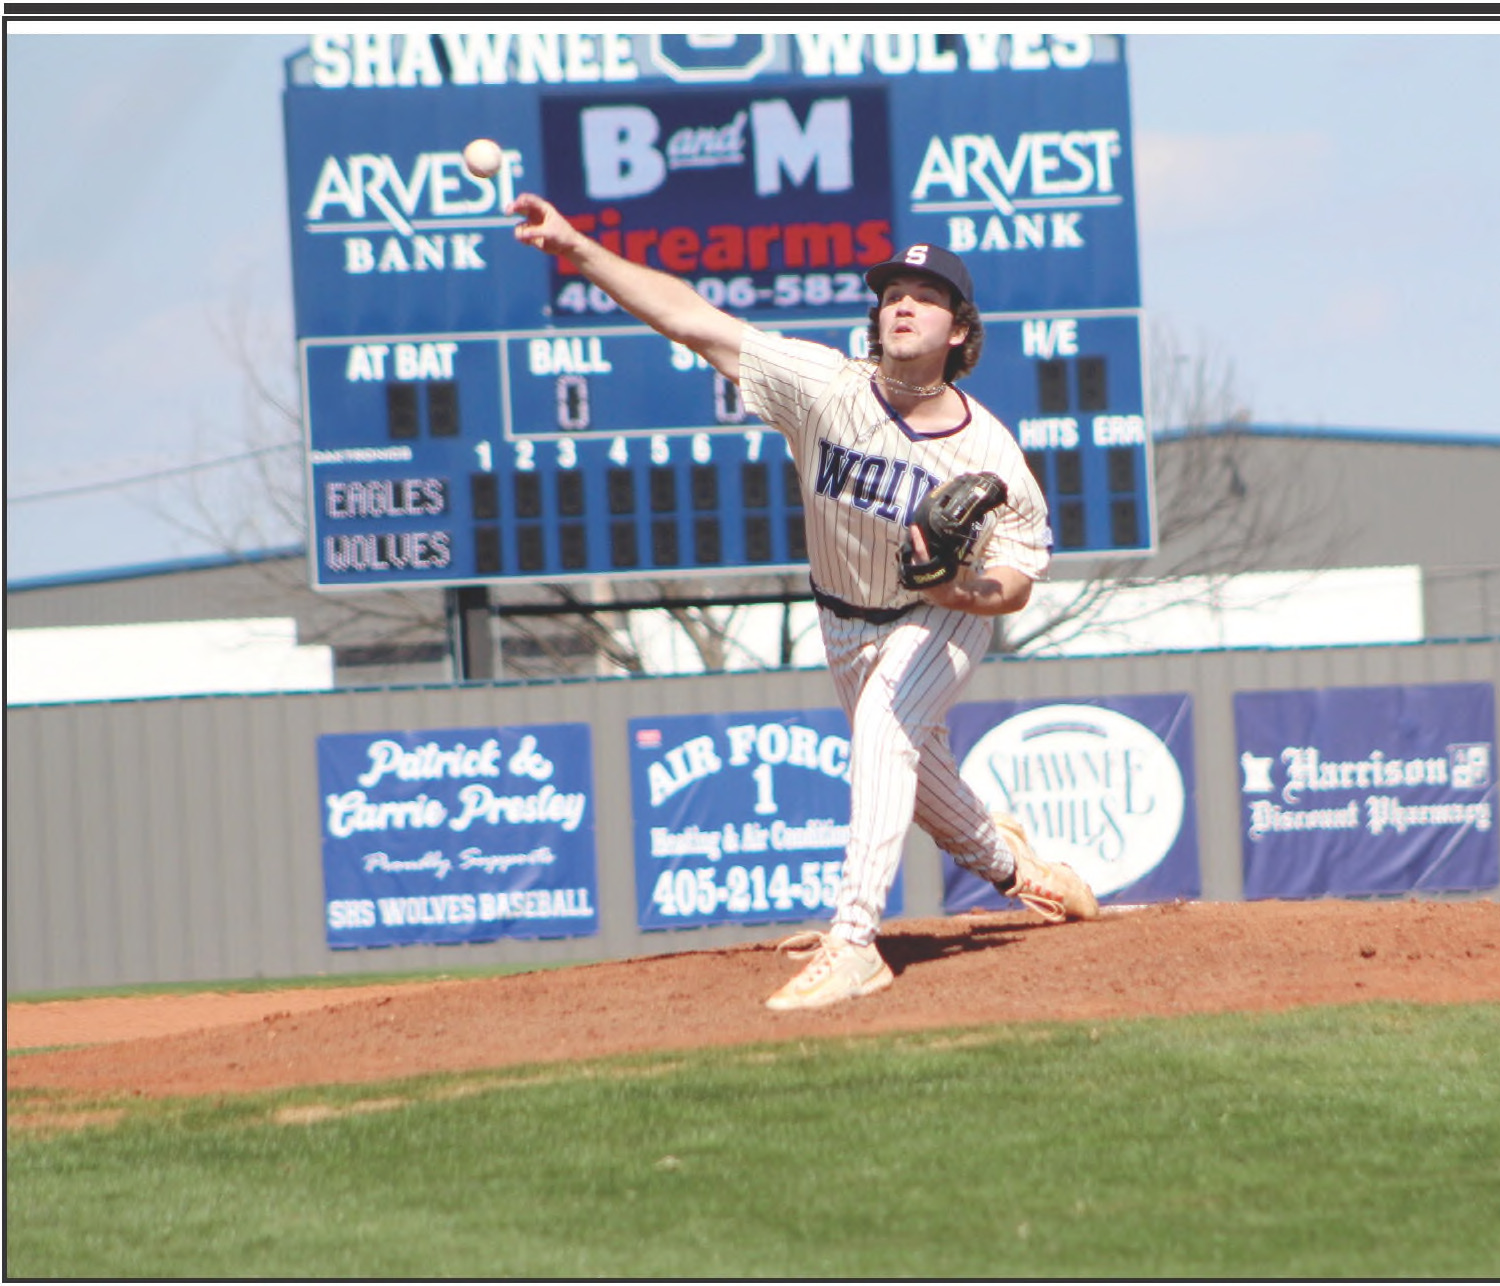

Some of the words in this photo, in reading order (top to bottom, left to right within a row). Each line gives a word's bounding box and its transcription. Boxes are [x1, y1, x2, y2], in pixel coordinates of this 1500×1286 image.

[310, 34, 639, 88] SHAWNEE
[795, 34, 1094, 77] WOLVES
[580, 106, 667, 199] B
[667, 111, 748, 158] and
[751, 98, 853, 196] M
[307, 150, 523, 236] ARVEST
[911, 129, 1121, 215] ARVEST
[344, 233, 487, 274] BANK
[947, 212, 1086, 252] BANK
[905, 245, 929, 265] S
[529, 337, 611, 375] BALL
[1022, 319, 1078, 360] H/E
[346, 345, 389, 381] AT
[395, 342, 458, 380] BAT
[475, 441, 492, 472] 1
[515, 438, 535, 471] 2
[557, 437, 577, 469] 3
[608, 436, 629, 467] 4
[651, 433, 671, 465] 5
[692, 432, 712, 464] 6
[743, 431, 763, 462] 7
[1019, 417, 1079, 451] HITS
[1092, 415, 1146, 447] ERR
[326, 479, 445, 518] EAGLES
[814, 437, 943, 530] WOLV
[324, 531, 451, 571] WOLVES
[358, 738, 502, 788] Patrick
[647, 735, 722, 807] AIR
[726, 723, 852, 784] FORC
[1280, 745, 1448, 804] Harrison
[327, 789, 448, 838] Carrie
[448, 782, 586, 832] Presley
[752, 762, 778, 815] 1
[1248, 799, 1360, 840] Discount
[1365, 795, 1492, 835] Pharmacy
[650, 825, 722, 861] Heating
[741, 821, 769, 852] Air
[770, 819, 852, 850] Condition
[328, 899, 376, 930] SHS
[377, 893, 477, 927] WOLVES
[478, 888, 595, 923] BASEBALL
[652, 860, 843, 917] 405-214-55
